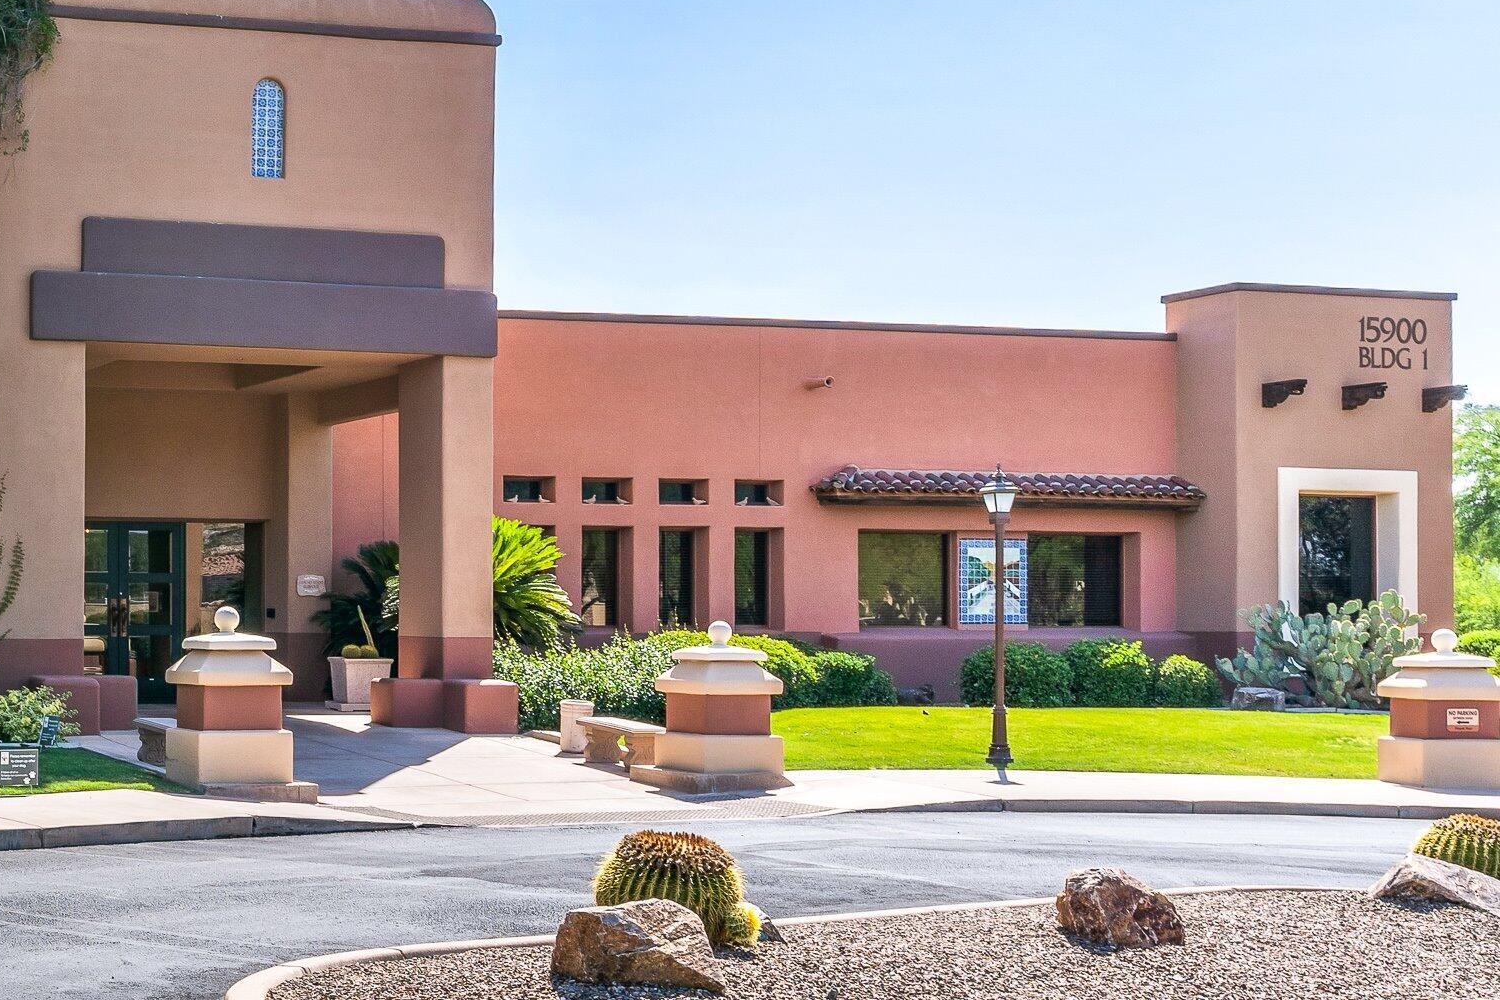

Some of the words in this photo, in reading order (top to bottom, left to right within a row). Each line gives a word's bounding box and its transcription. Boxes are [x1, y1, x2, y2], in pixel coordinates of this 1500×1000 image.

[1358, 316, 1427, 344] 15900
[1359, 346, 1412, 370] BLDG
[1422, 347, 1428, 370] 1
